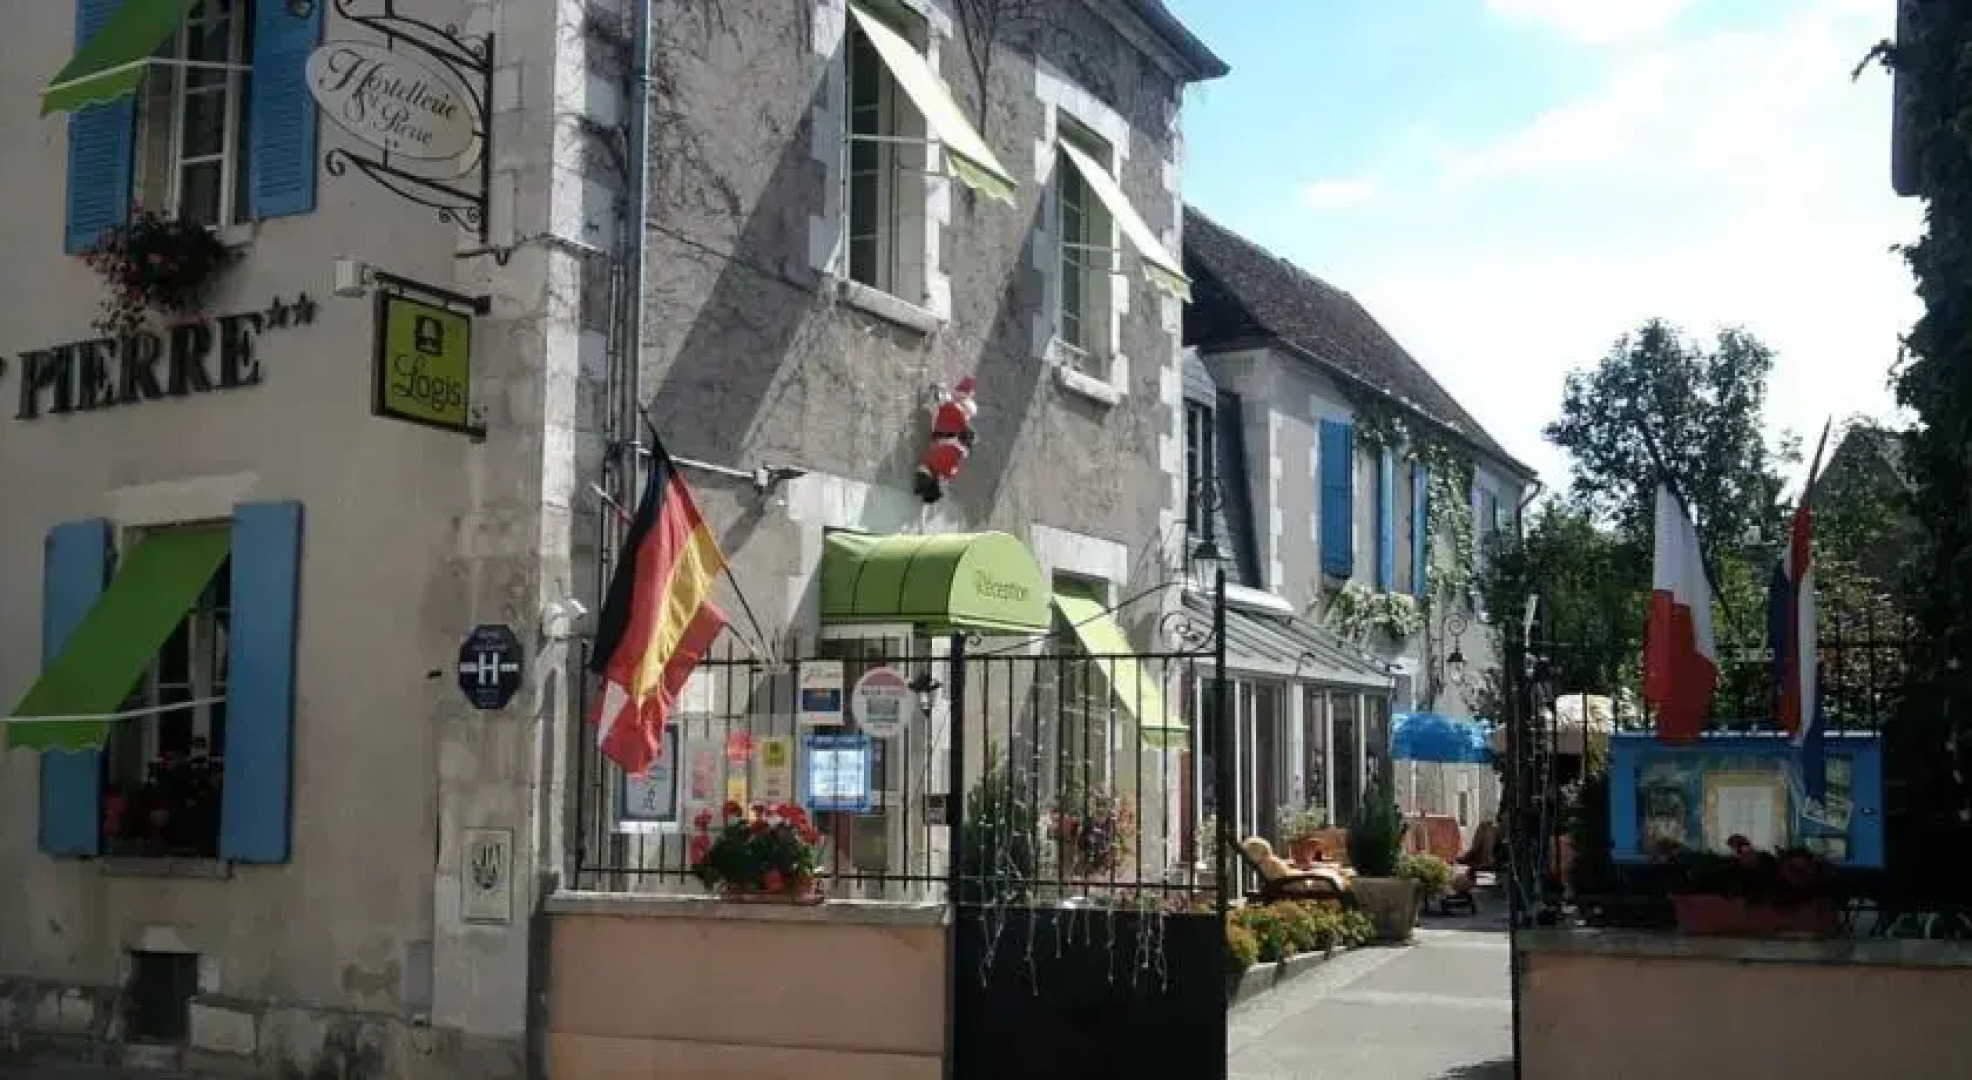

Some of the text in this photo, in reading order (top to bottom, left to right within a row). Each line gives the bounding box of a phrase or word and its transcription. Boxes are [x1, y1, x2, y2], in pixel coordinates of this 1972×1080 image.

[318, 48, 458, 120] Hostellerie
[392, 354, 463, 413] Logis
[478, 651, 499, 686] H
